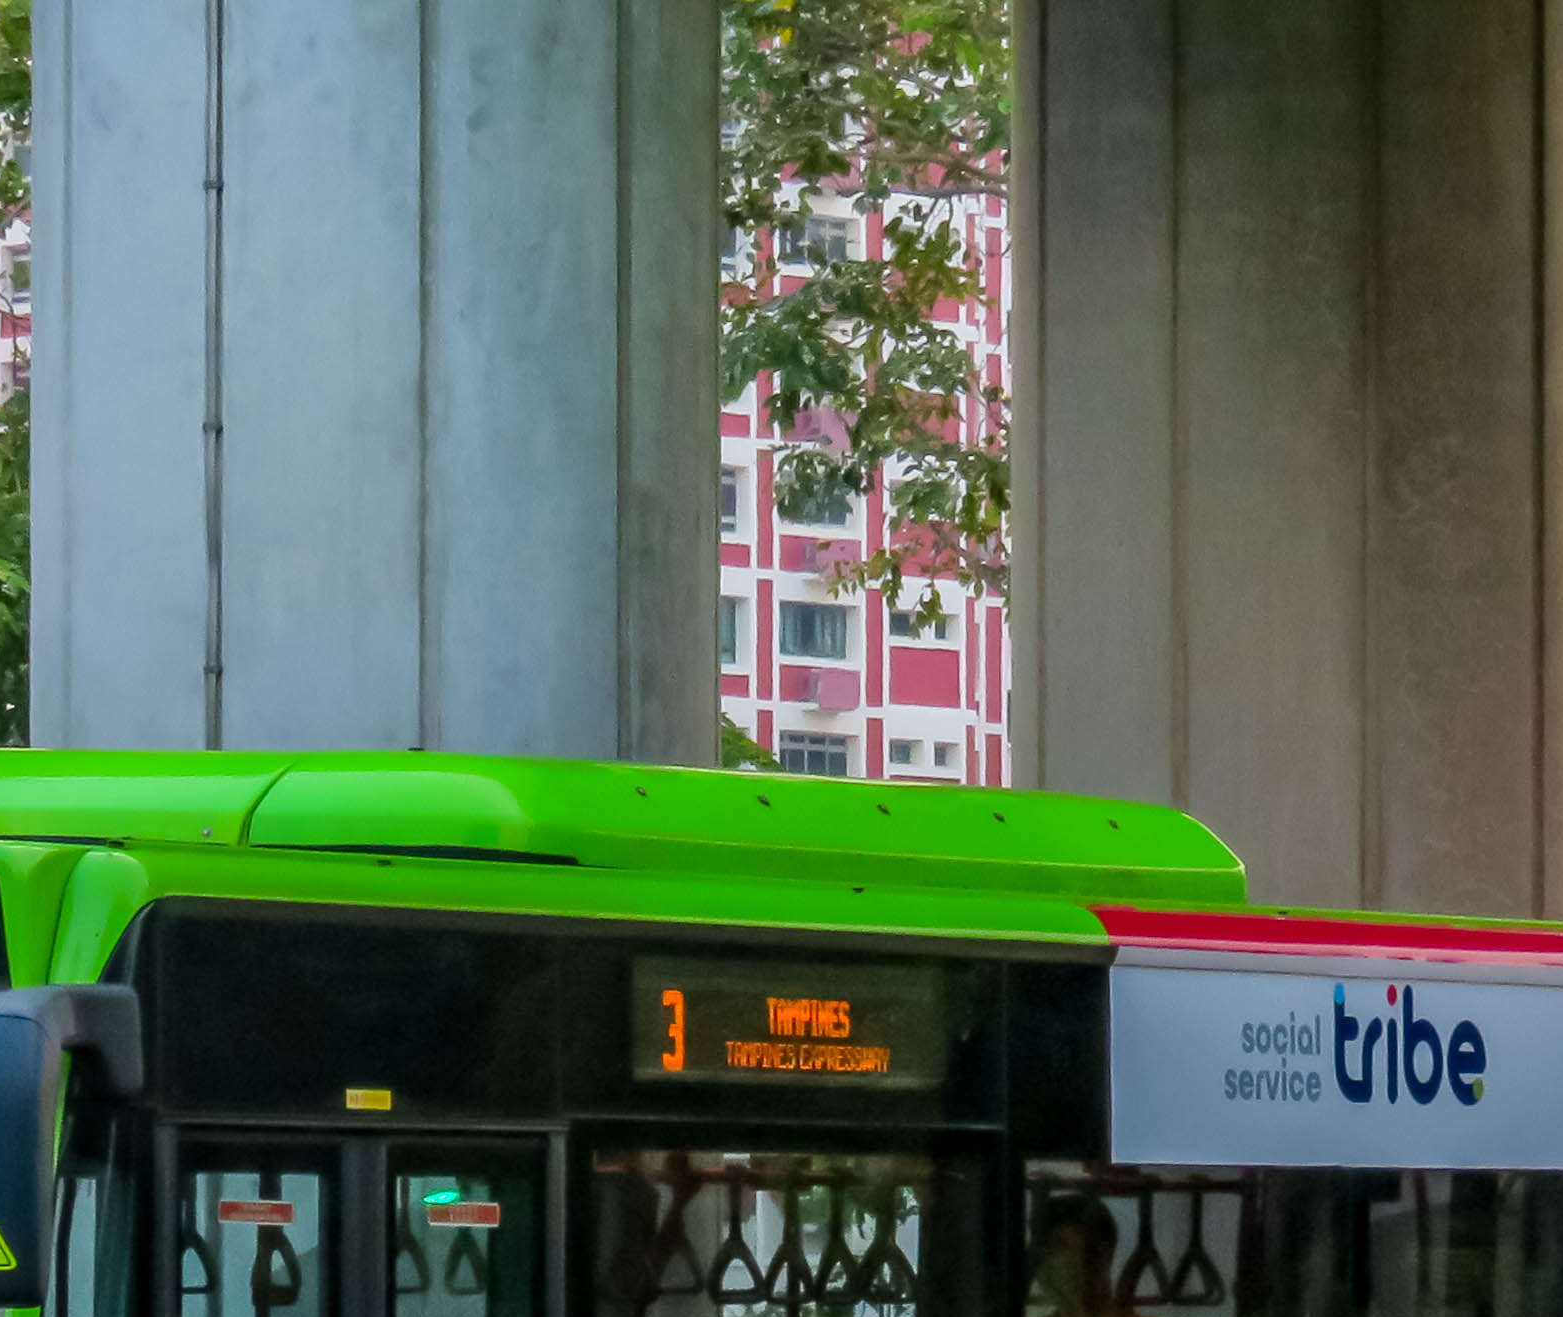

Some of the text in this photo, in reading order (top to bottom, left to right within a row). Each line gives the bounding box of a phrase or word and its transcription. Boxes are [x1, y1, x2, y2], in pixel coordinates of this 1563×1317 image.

[661, 988, 685, 1072] 3
[766, 996, 851, 1039] TAMPINES
[1241, 1010, 1322, 1056] social
[725, 1040, 795, 1070] TAMPINES
[1333, 982, 1488, 1106] tribe
[1223, 1057, 1322, 1101] service
